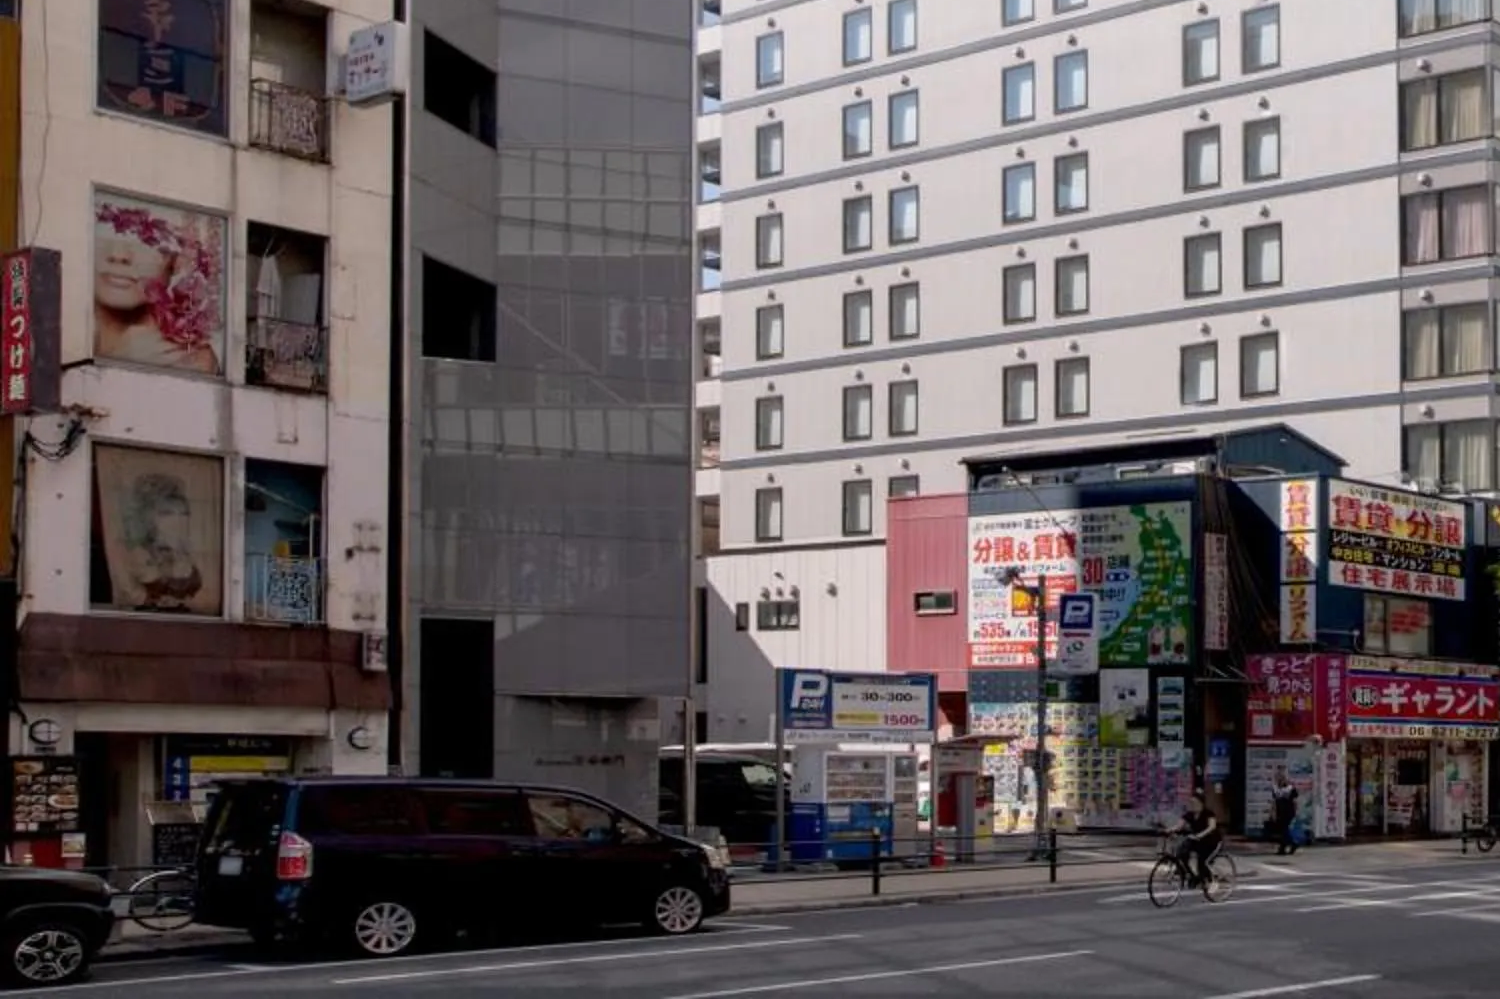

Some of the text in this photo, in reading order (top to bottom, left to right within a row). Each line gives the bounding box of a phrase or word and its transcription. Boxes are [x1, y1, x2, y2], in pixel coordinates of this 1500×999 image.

[791, 673, 829, 709] P
[1381, 681, 1494, 717] ギャラント
